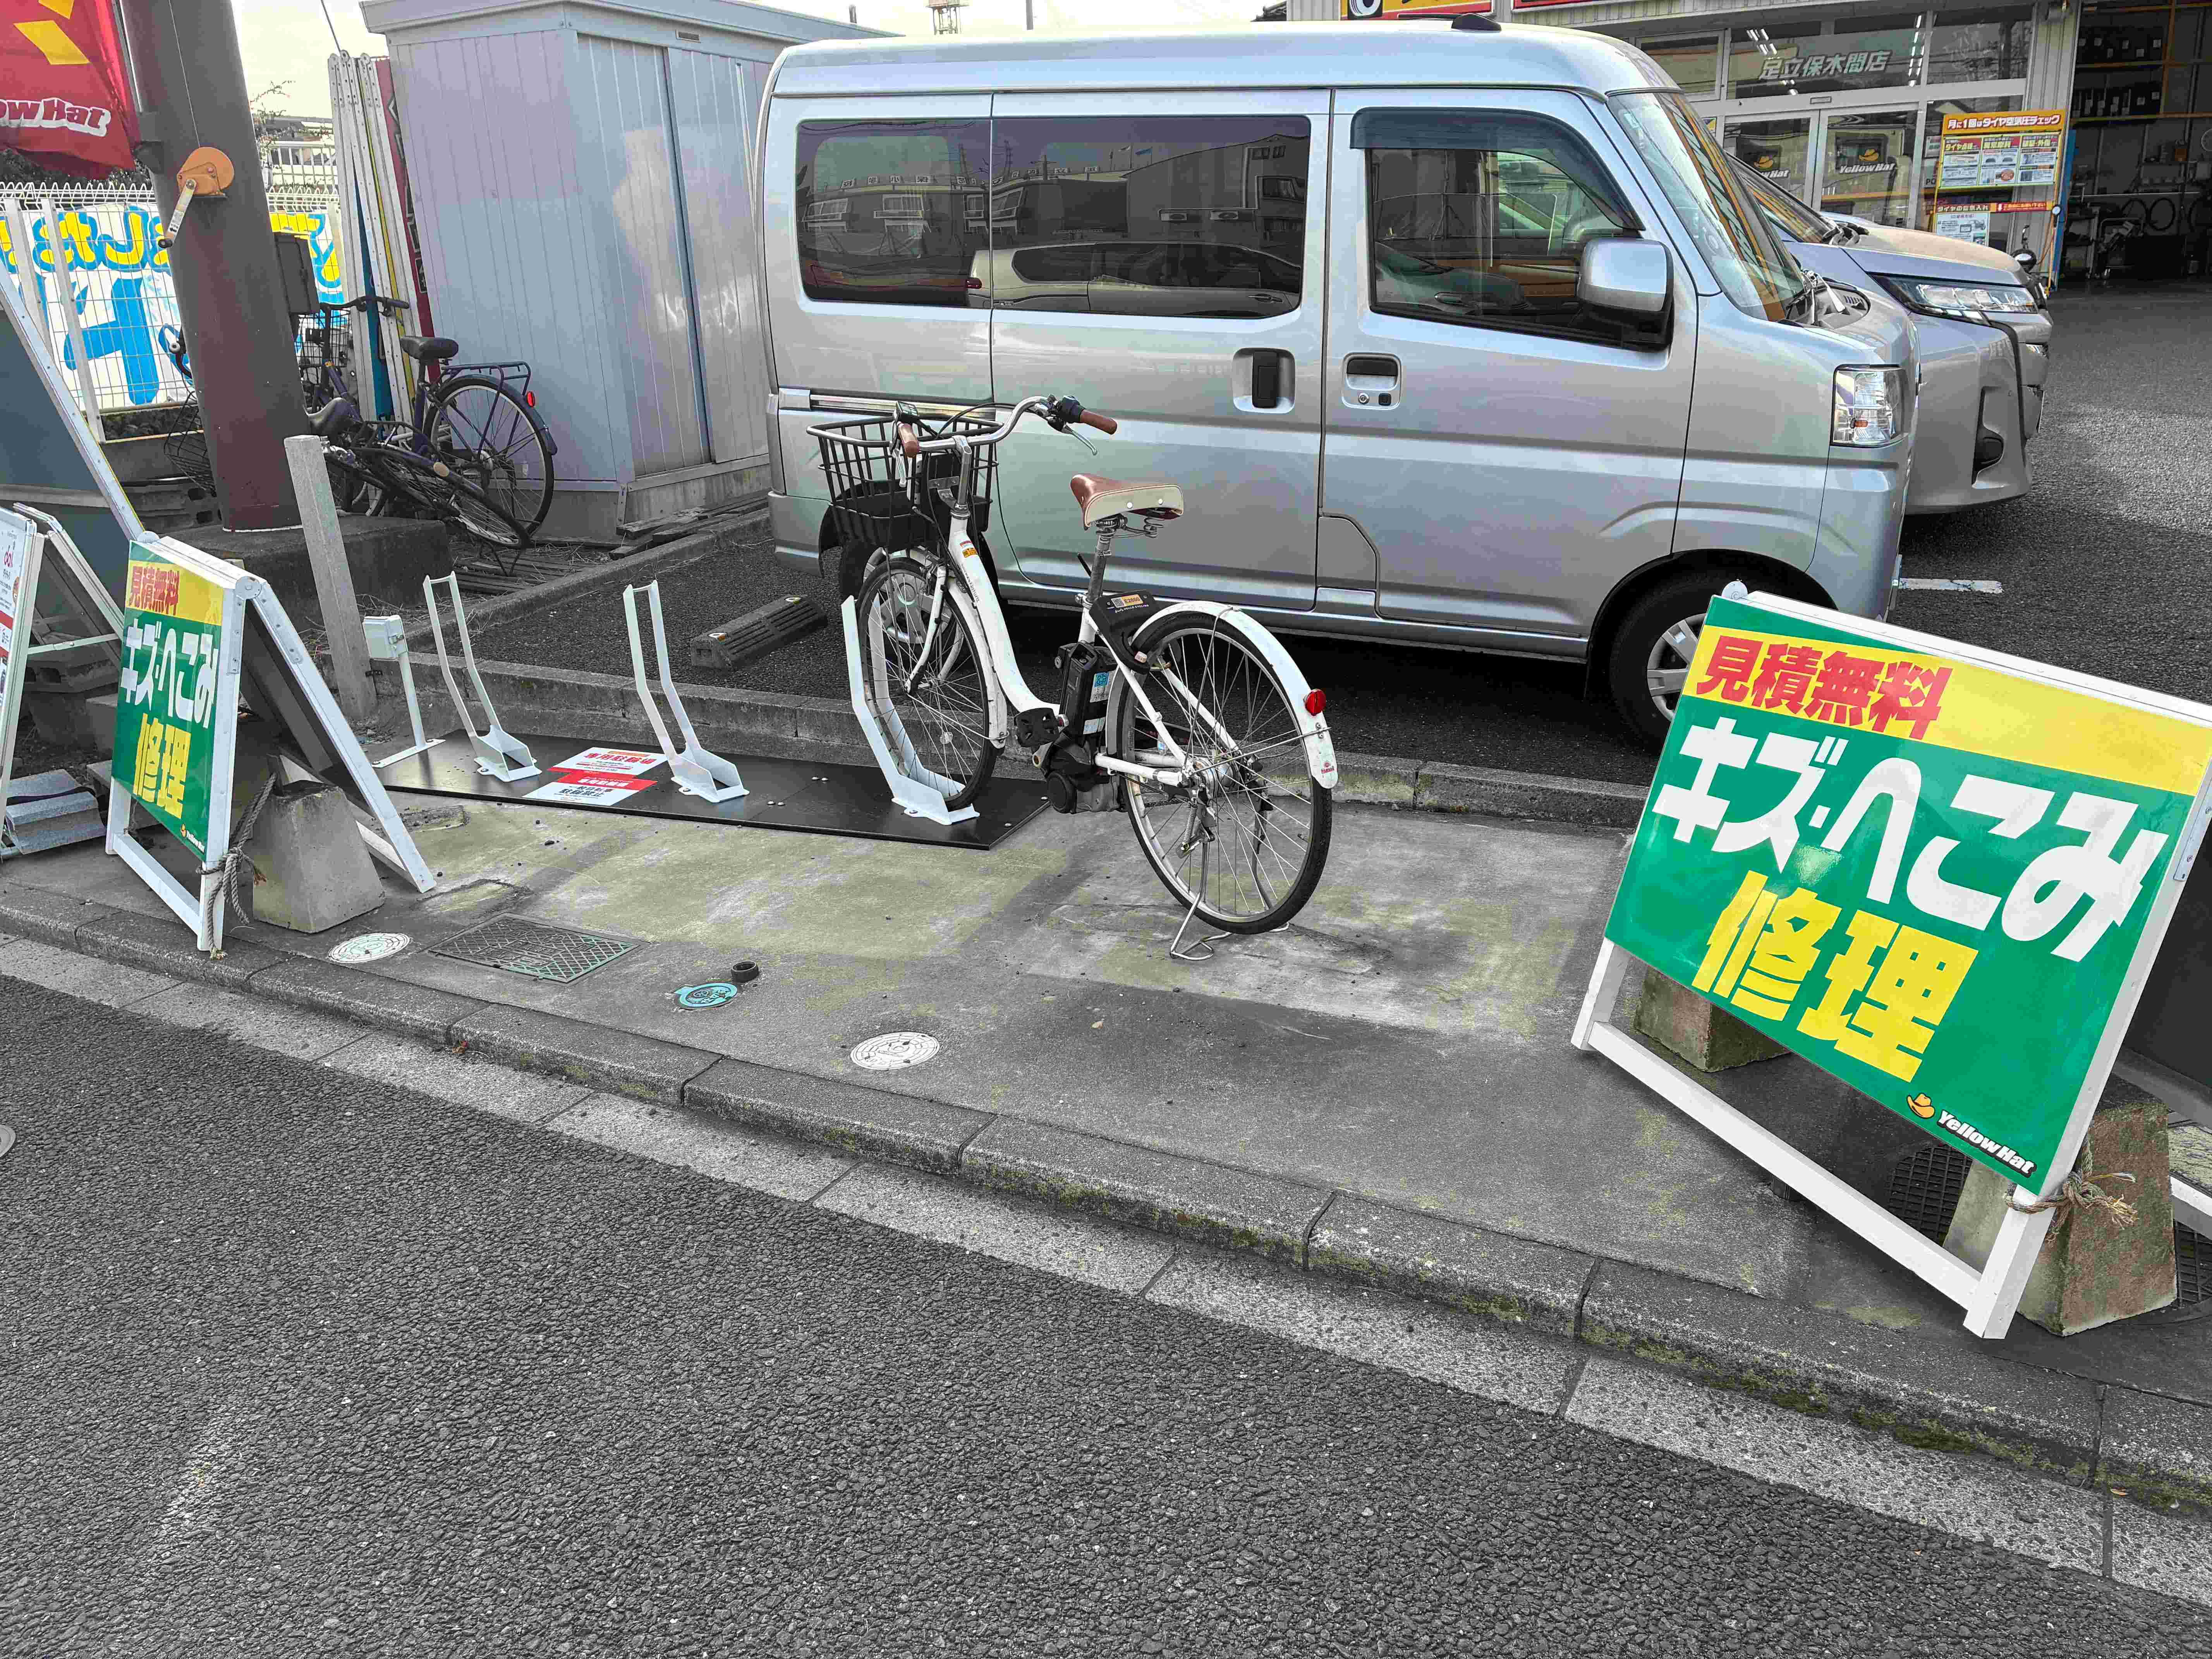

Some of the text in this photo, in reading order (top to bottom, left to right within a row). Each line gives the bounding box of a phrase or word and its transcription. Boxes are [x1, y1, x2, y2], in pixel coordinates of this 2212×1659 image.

[1759, 49, 1891, 80] 足立保木間店
[1948, 114, 2060, 129] 月に1回はタイヤ空気圧チェック
[1839, 161, 1896, 174] YellowHat
[129, 565, 180, 616] 見積無料
[1695, 634, 1954, 740] 見積無料
[133, 713, 192, 819] 修理
[1652, 716, 2169, 963] キズ・へこみ
[1692, 870, 1979, 1083] 修理
[1937, 1109, 2035, 1175] YellowHat
